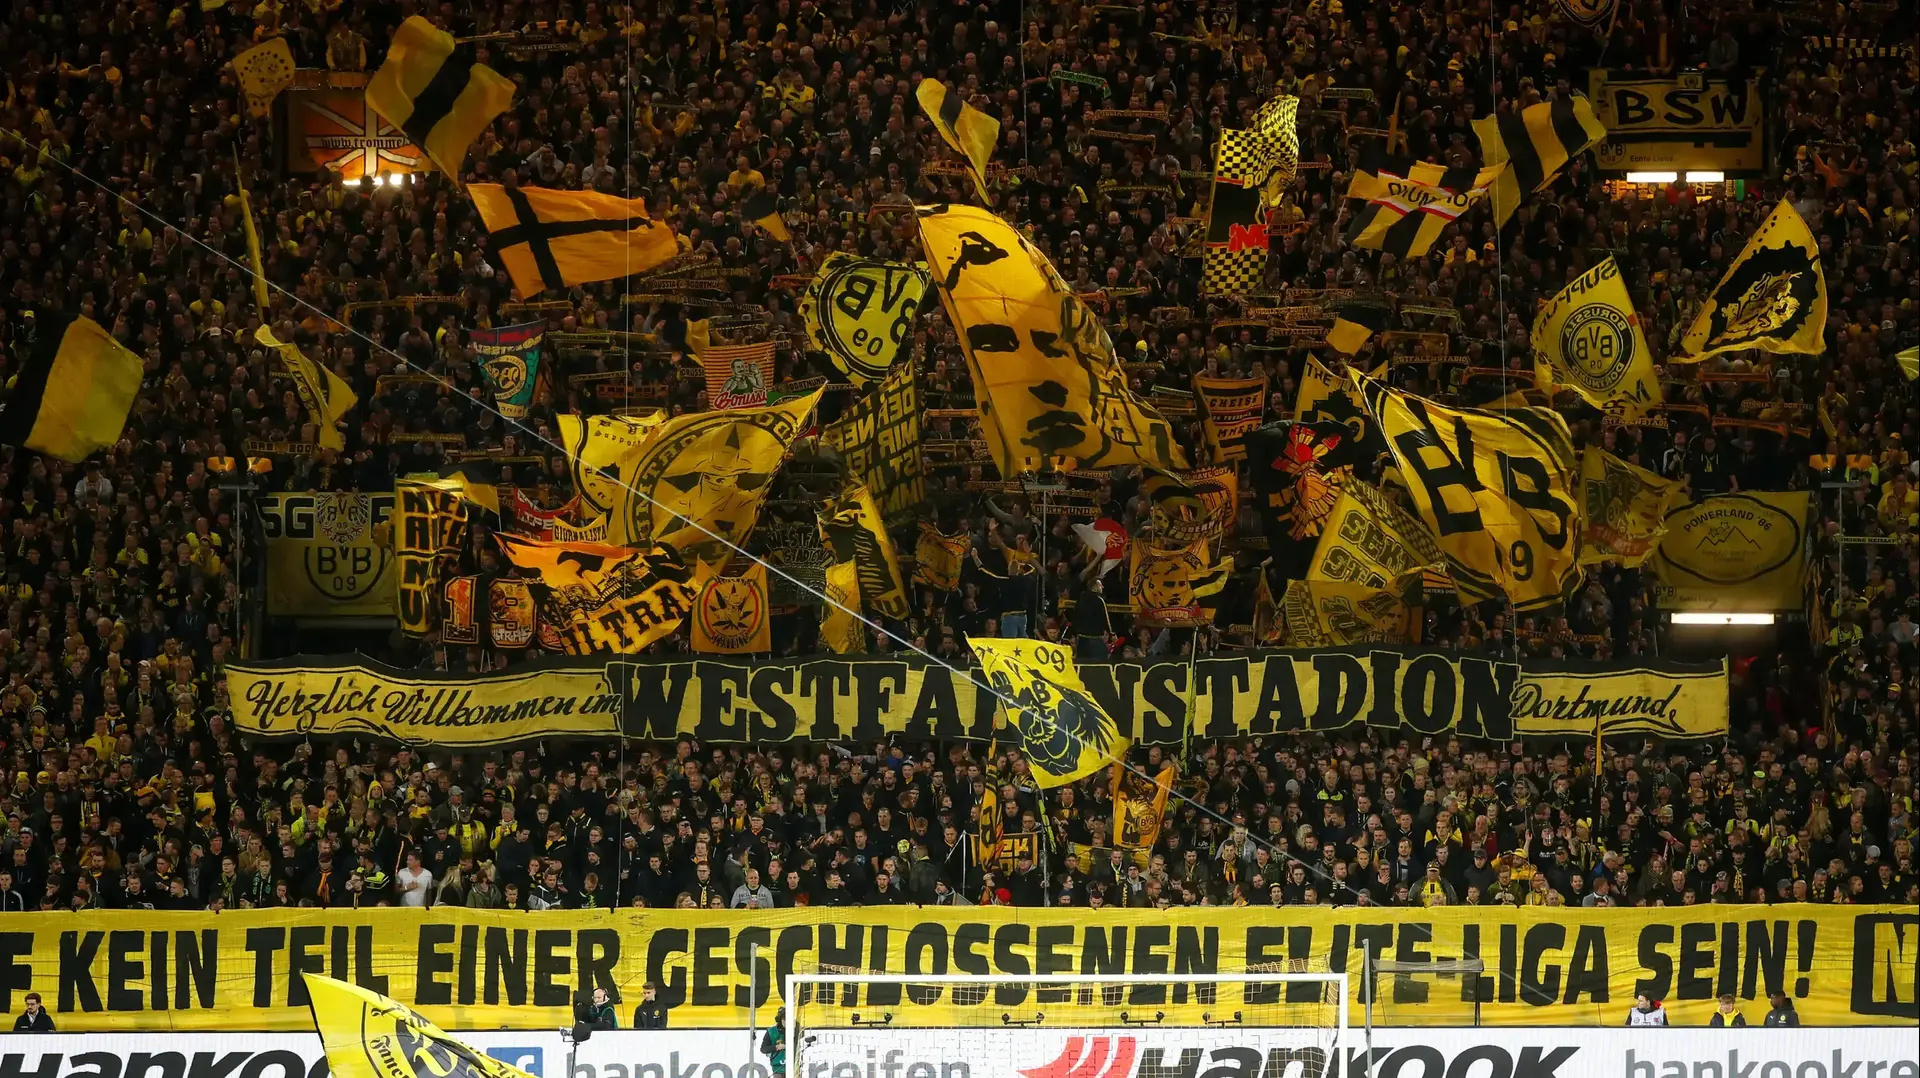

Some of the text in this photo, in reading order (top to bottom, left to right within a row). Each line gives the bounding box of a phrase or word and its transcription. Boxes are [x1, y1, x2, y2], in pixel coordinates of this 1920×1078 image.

[1614, 89, 1747, 126] BSW
[1306, 362, 1333, 387] THE
[1205, 394, 1259, 408] CHEISS
[1683, 508, 1755, 532] POWERLAND
[554, 524, 608, 543] GIORNALISTA
[333, 575, 357, 592] 09
[1034, 645, 1065, 673] 09
[246, 676, 621, 733] Herzlich Willkommen im
[58, 931, 219, 1013] KEIN
[245, 926, 389, 1007] TEIL
[414, 924, 622, 1006] EINER
[646, 921, 1219, 1008] GESCHLOSSENEN
[1244, 922, 1609, 1006] ELITE-LIGA
[1635, 919, 1817, 1001] SEIN!
